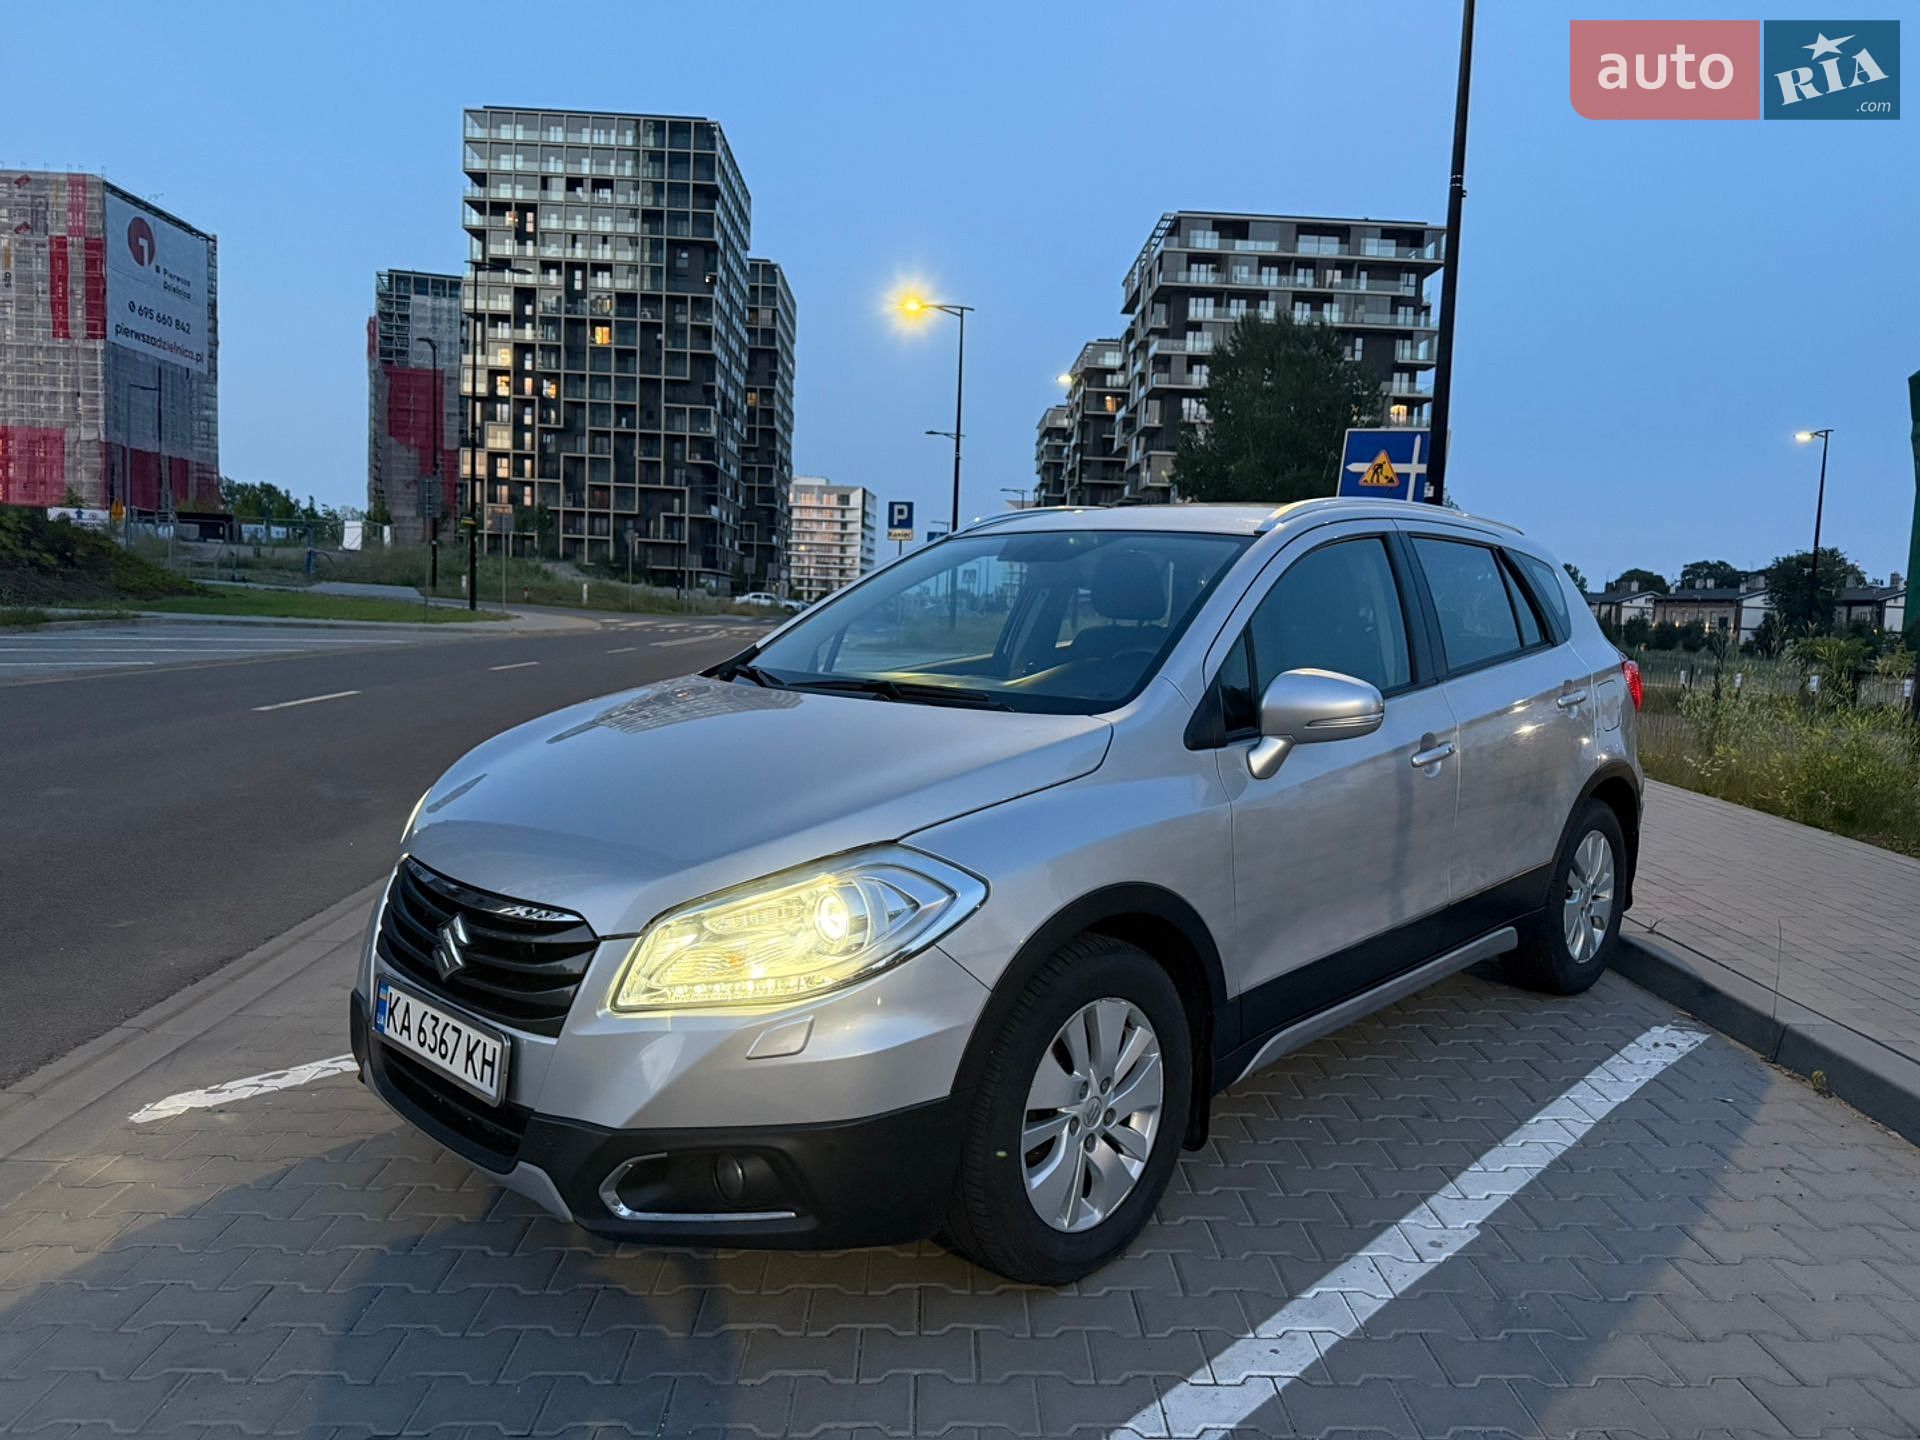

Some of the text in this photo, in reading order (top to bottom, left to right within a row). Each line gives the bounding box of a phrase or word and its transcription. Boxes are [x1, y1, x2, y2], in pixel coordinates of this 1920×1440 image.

[137, 305, 191, 335] 695 660 842
[115, 322, 203, 363] pierwszadzielnica.pl
[893, 504, 908, 526] P
[387, 992, 496, 1088] KA 6367 KH
